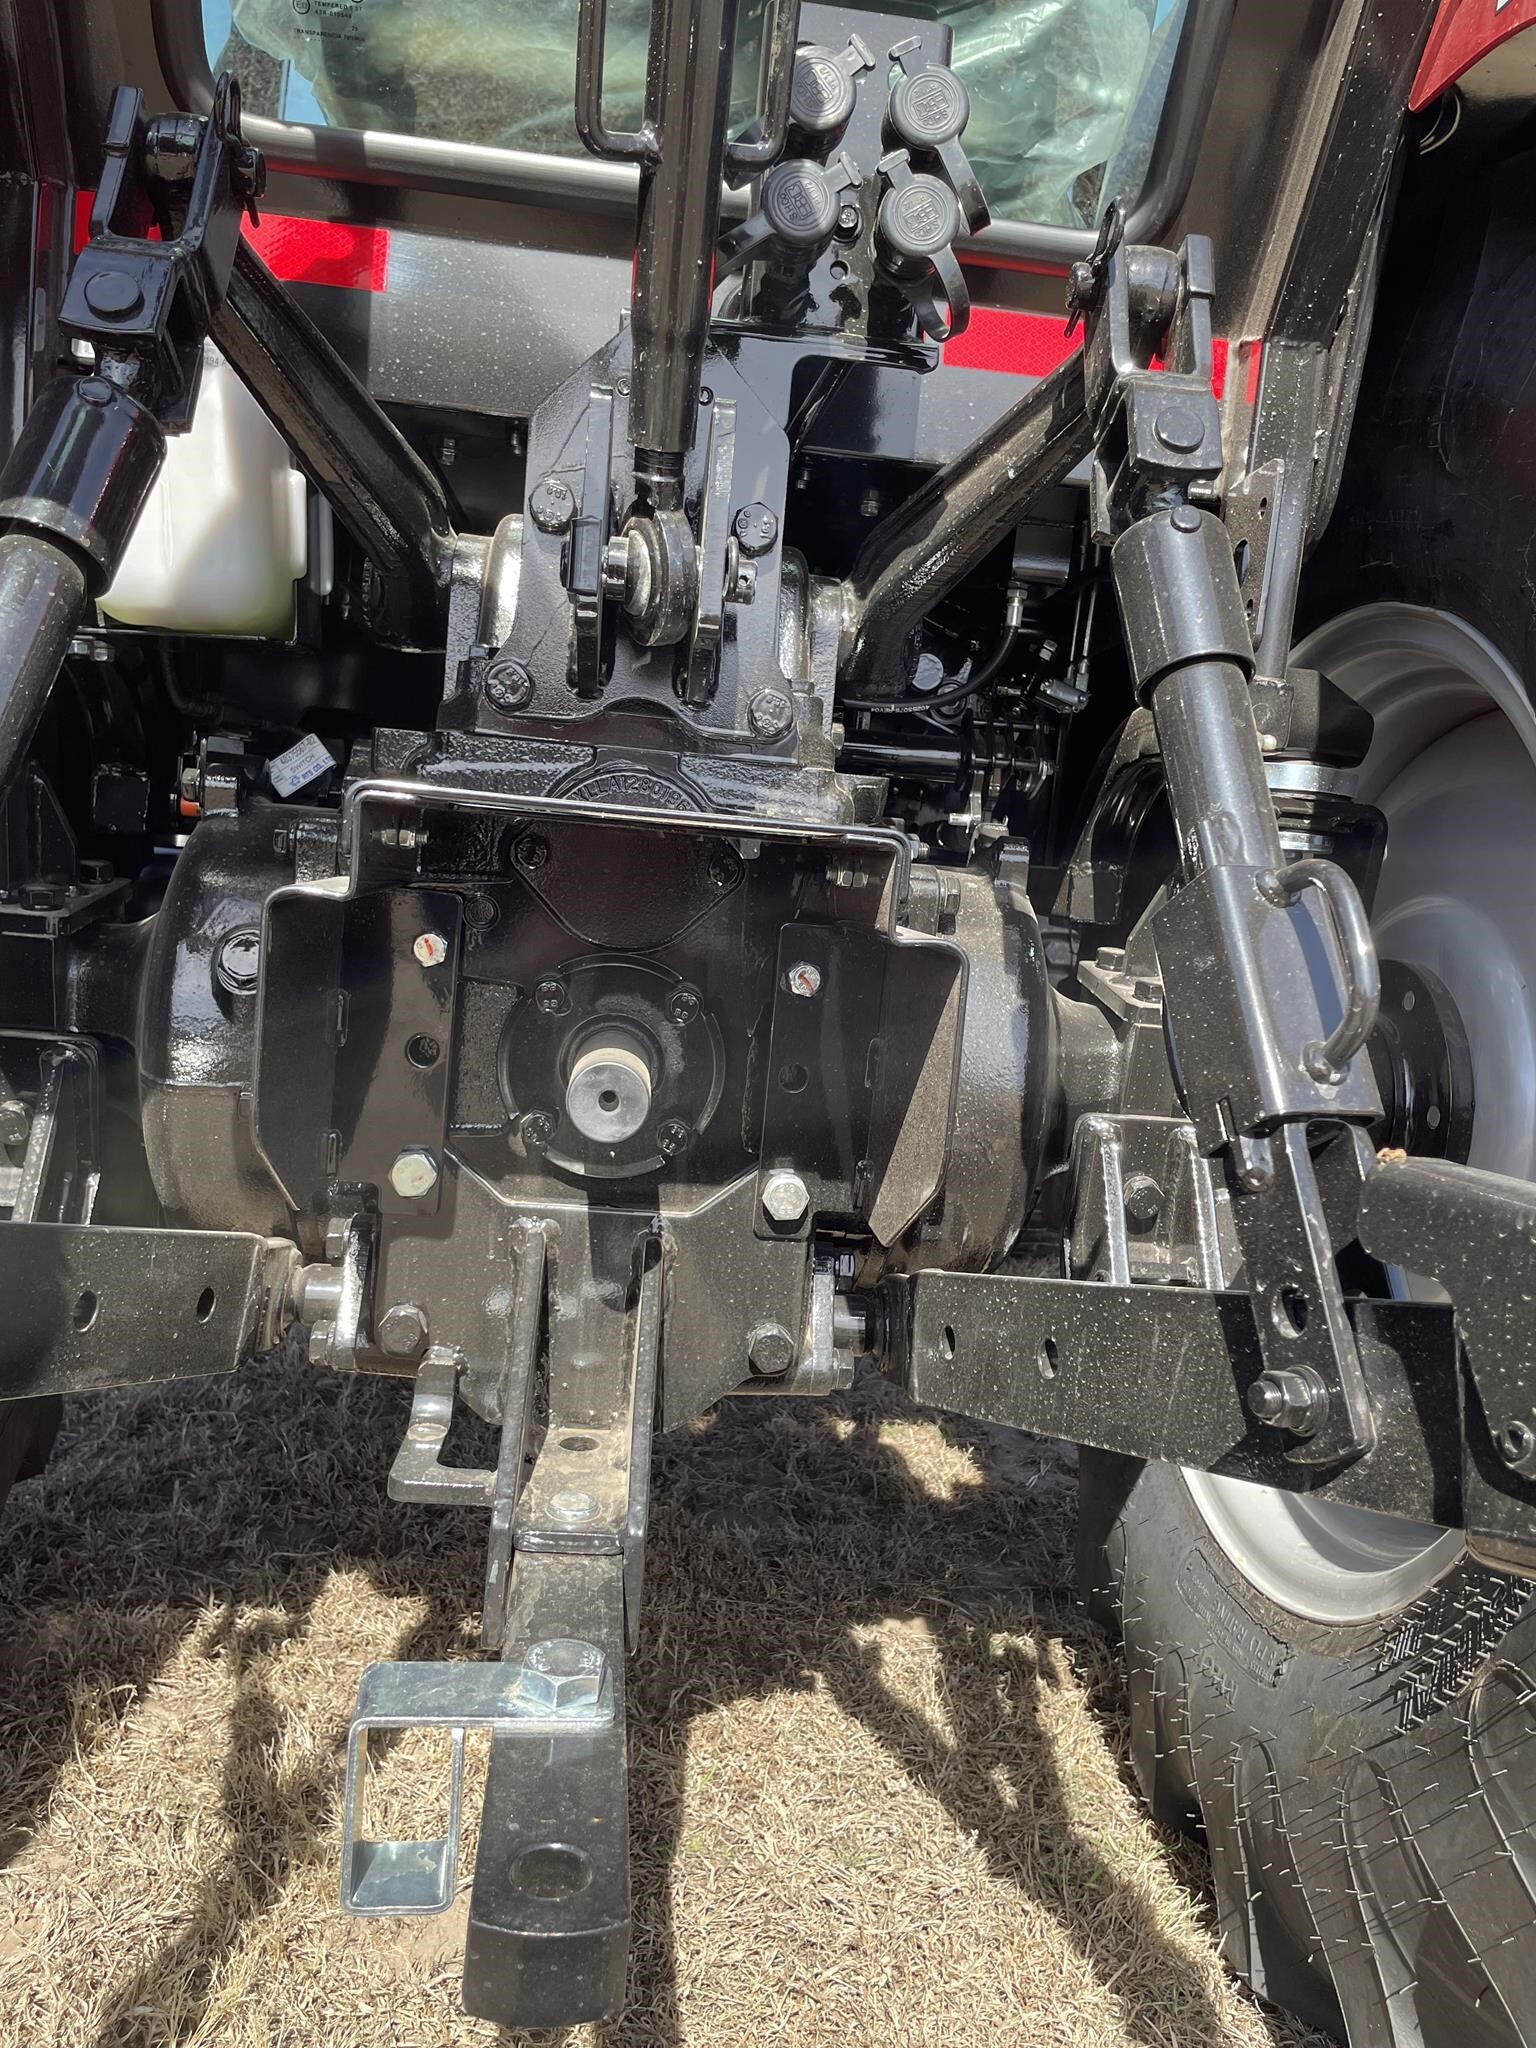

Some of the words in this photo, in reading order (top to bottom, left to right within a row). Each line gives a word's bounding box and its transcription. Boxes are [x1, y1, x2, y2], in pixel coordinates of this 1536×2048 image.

[779, 192, 799, 221] SHCO
[289, 753, 315, 774] SWITCH
[1210, 1598, 1249, 1645] RATING
[1249, 1635, 1269, 1661] PLY
